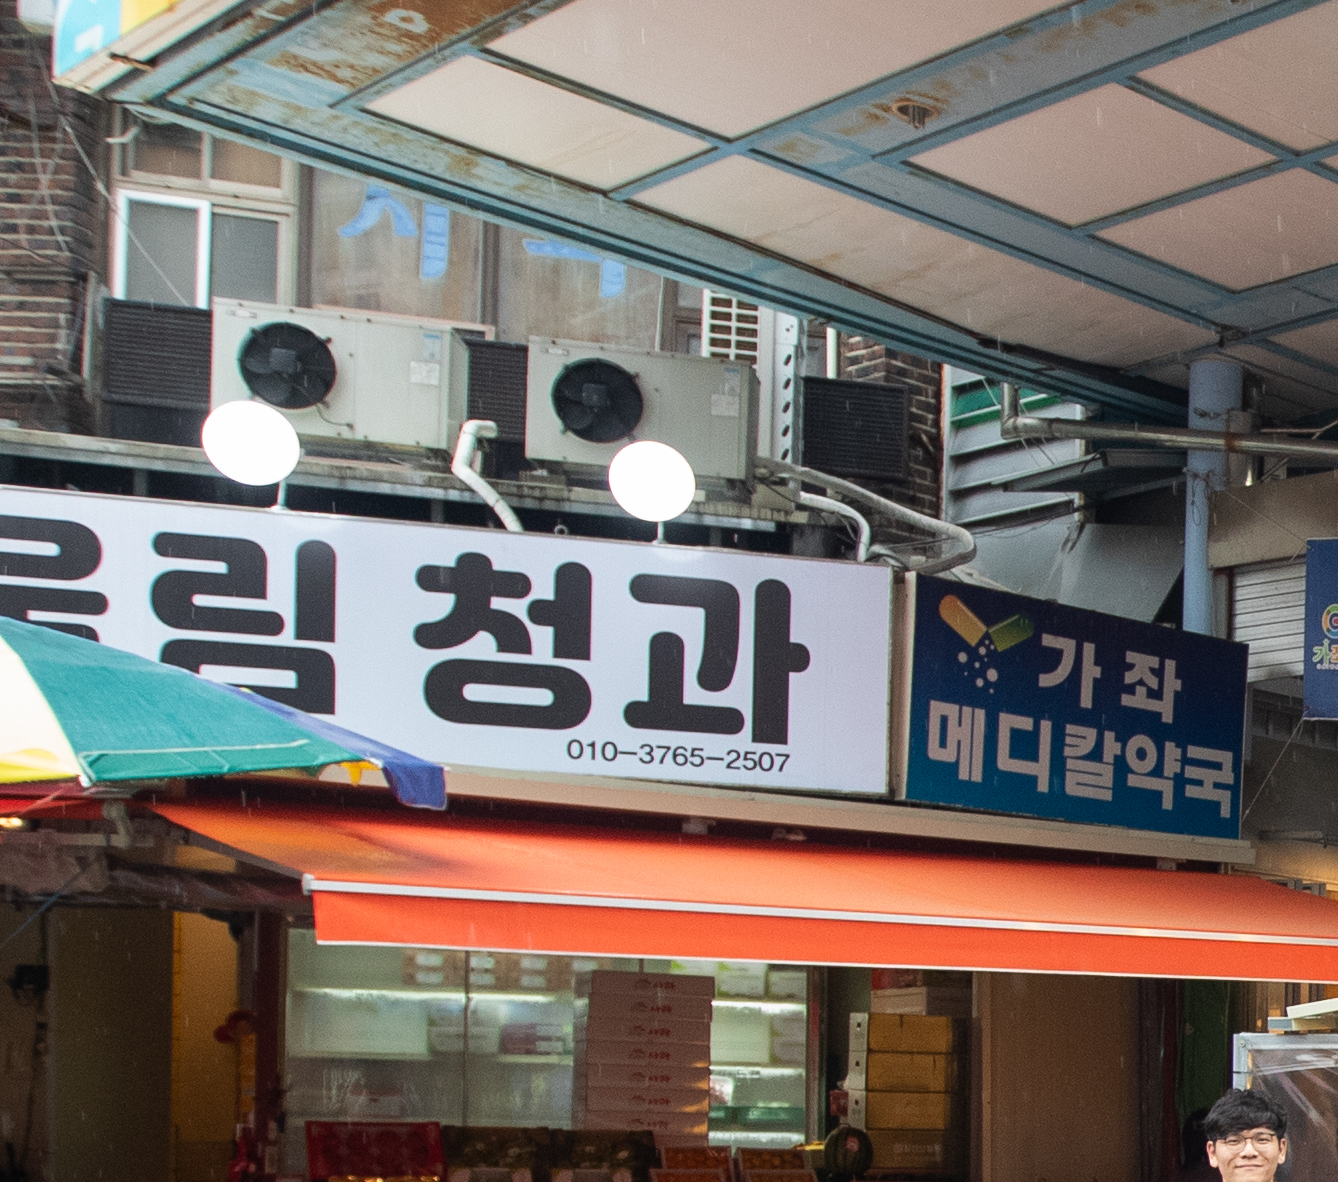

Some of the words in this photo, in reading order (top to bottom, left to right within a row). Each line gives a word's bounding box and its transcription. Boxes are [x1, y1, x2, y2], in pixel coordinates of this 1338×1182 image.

[413, 550, 812, 746] 청과
[567, 738, 791, 774] 010-3765-2507
[927, 699, 1236, 818] 메디칼약국
